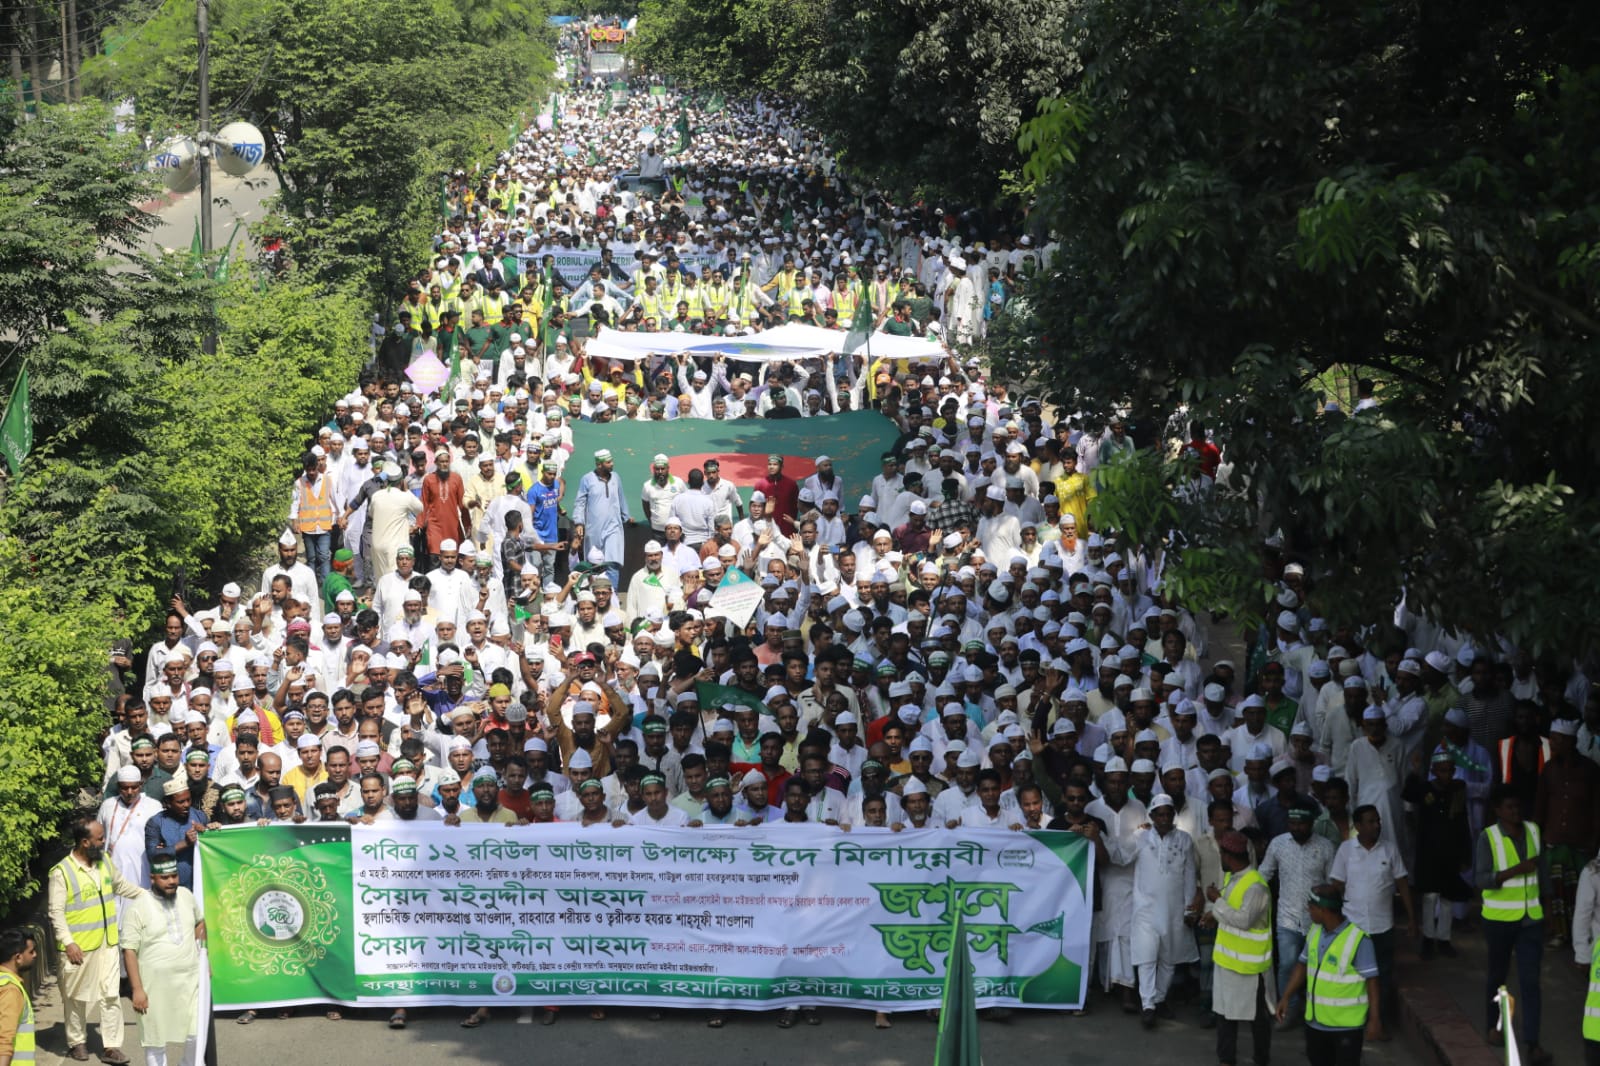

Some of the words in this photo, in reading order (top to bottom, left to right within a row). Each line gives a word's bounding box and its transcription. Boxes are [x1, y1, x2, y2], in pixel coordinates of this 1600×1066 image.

[361, 838, 419, 861] পবিত্র
[429, 844, 459, 863] ১২
[466, 838, 541, 861] রবিউল
[547, 839, 634, 862] আউয়াল
[641, 840, 738, 864] উপলক্ষ্যে
[748, 842, 822, 867] ঈদে
[830, 841, 990, 871] মিলাদুন্নবী
[369, 867, 389, 880] মহতী
[391, 870, 423, 880] সমাবেশে
[555, 870, 571, 881] মহান
[358, 882, 431, 906] সৈয়দ
[438, 881, 549, 910] মইনুদ্দীন
[555, 887, 648, 908] আহমদ
[362, 909, 411, 927] স্থলাভিষিক্ত
[414, 912, 471, 925] খেলাফতপ্রাপ্ত
[475, 912, 515, 927] আওলাদ,
[519, 912, 555, 925] রাহবারে
[559, 908, 592, 925] শরীয়ত
[595, 913, 603, 924] ও
[645, 912, 673, 926] হযরত
[715, 914, 754, 928] মাওলানা
[359, 932, 429, 956] সৈয়দ
[436, 929, 555, 964] সাইফুদ্দীন
[561, 934, 650, 957] আহমদ
[362, 979, 464, 991] ব্যবস্থাপনায়
[658, 978, 763, 997] রহমানিয়া
[769, 977, 853, 996] মইনীয়া
